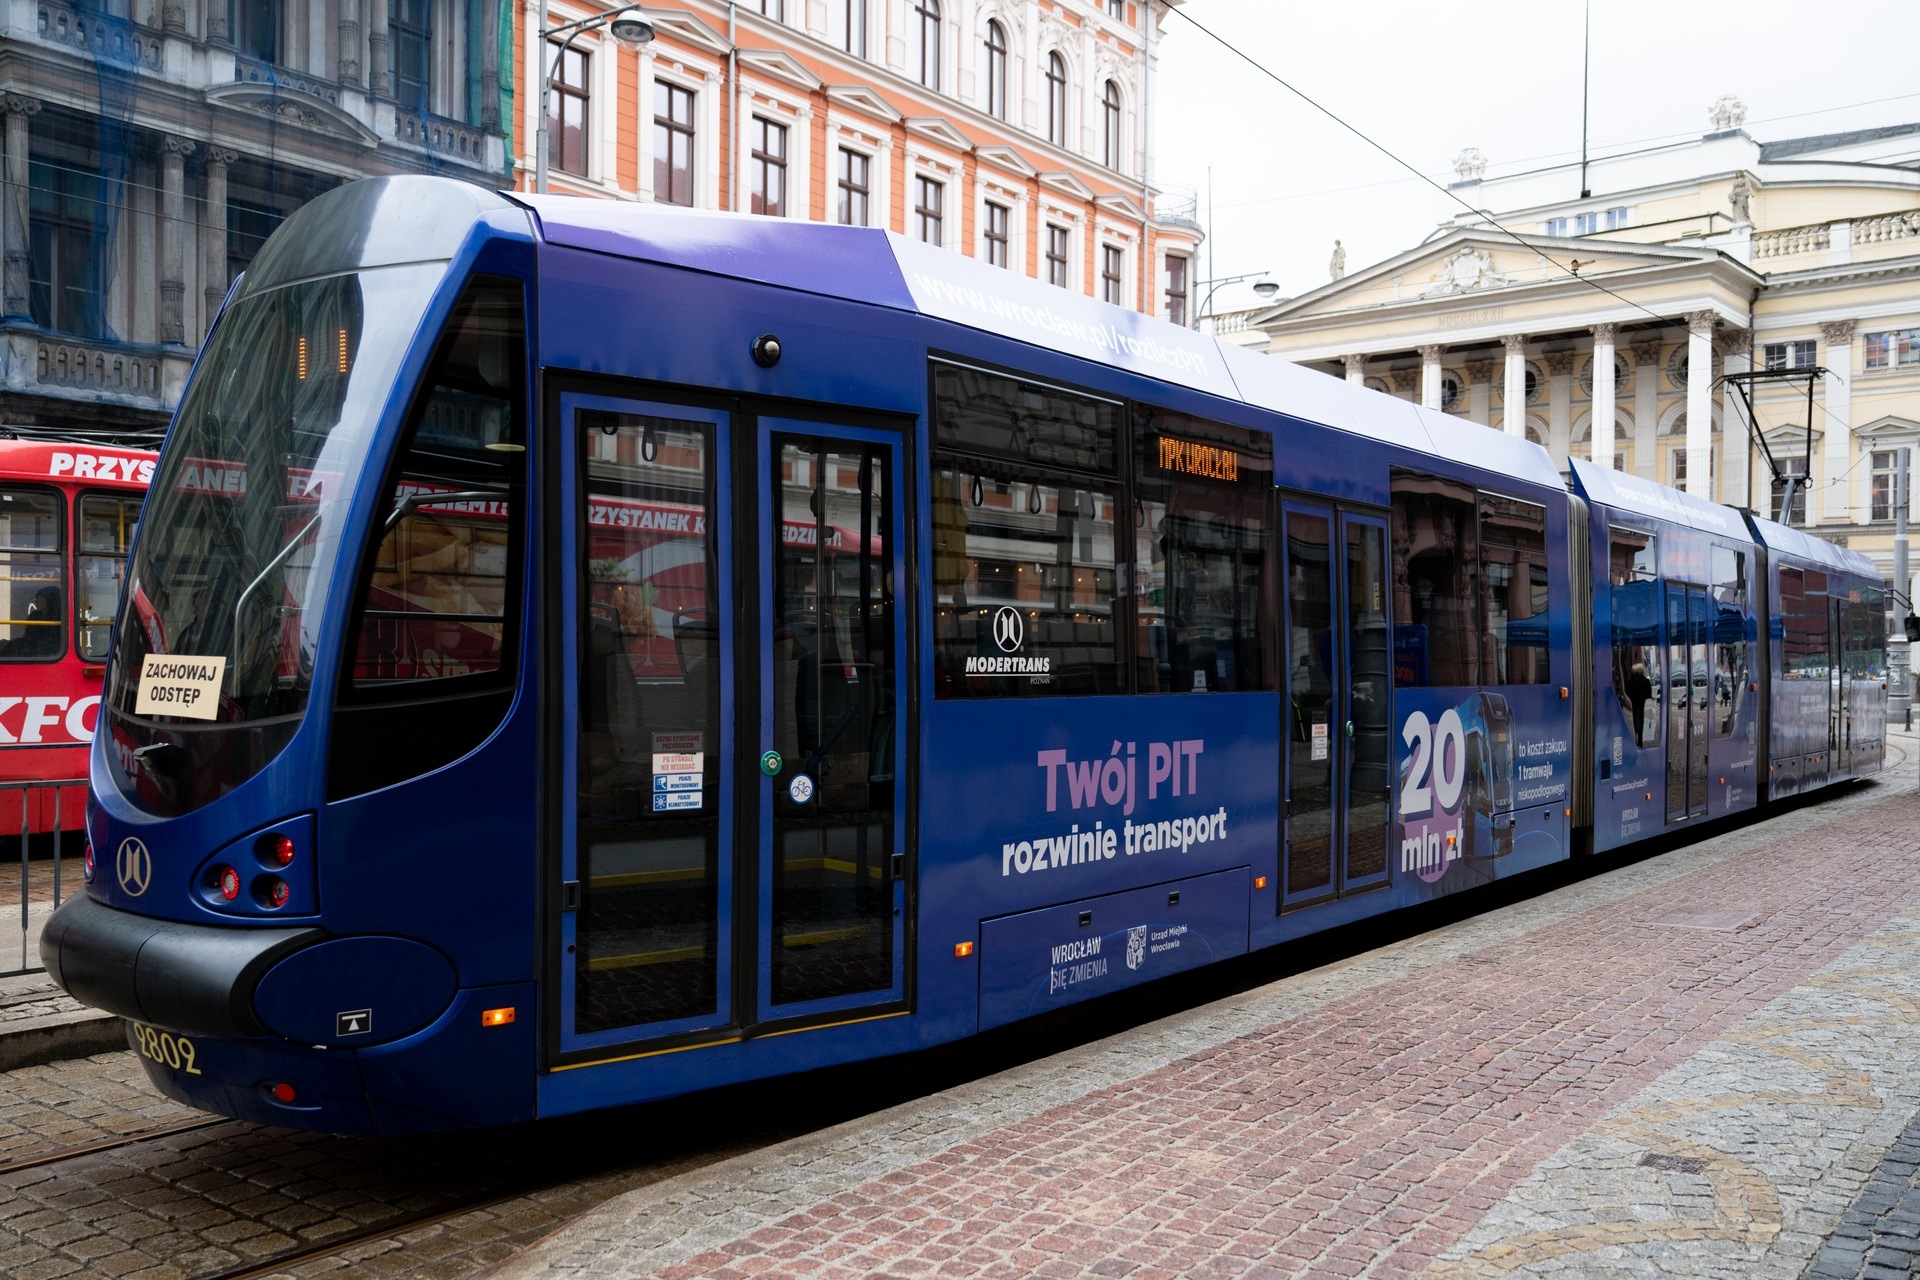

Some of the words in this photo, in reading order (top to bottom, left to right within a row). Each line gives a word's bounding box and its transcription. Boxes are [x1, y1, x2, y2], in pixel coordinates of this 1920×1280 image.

[913, 272, 1211, 378] www.wroclaw.pl/rozliczPIT
[1159, 436, 1185, 472] MPK
[1186, 442, 1238, 482] WROCŁAW
[146, 663, 217, 682] ZACHOWAJ
[965, 656, 1050, 672] MODERTRANS
[150, 686, 201, 708] ODSTĘP
[1518, 743, 1526, 757] to
[1527, 741, 1545, 756] koszt
[1545, 738, 1567, 755] zakupu
[1401, 708, 1466, 816] 20
[1523, 761, 1553, 780] tramwaju
[1037, 739, 1136, 816] Twój
[1148, 739, 1204, 800] PIT
[1002, 821, 1118, 876] rozwinie
[1123, 806, 1227, 854] transport
[1401, 824, 1440, 873] mln
[1445, 818, 1464, 861] zł
[1151, 927, 1168, 941] Urząd
[1169, 923, 1188, 937] Miejski
[1051, 935, 1102, 965] WROCŁAW
[1150, 940, 1180, 954] Wrocławia
[1068, 957, 1108, 985] ZMIENIA
